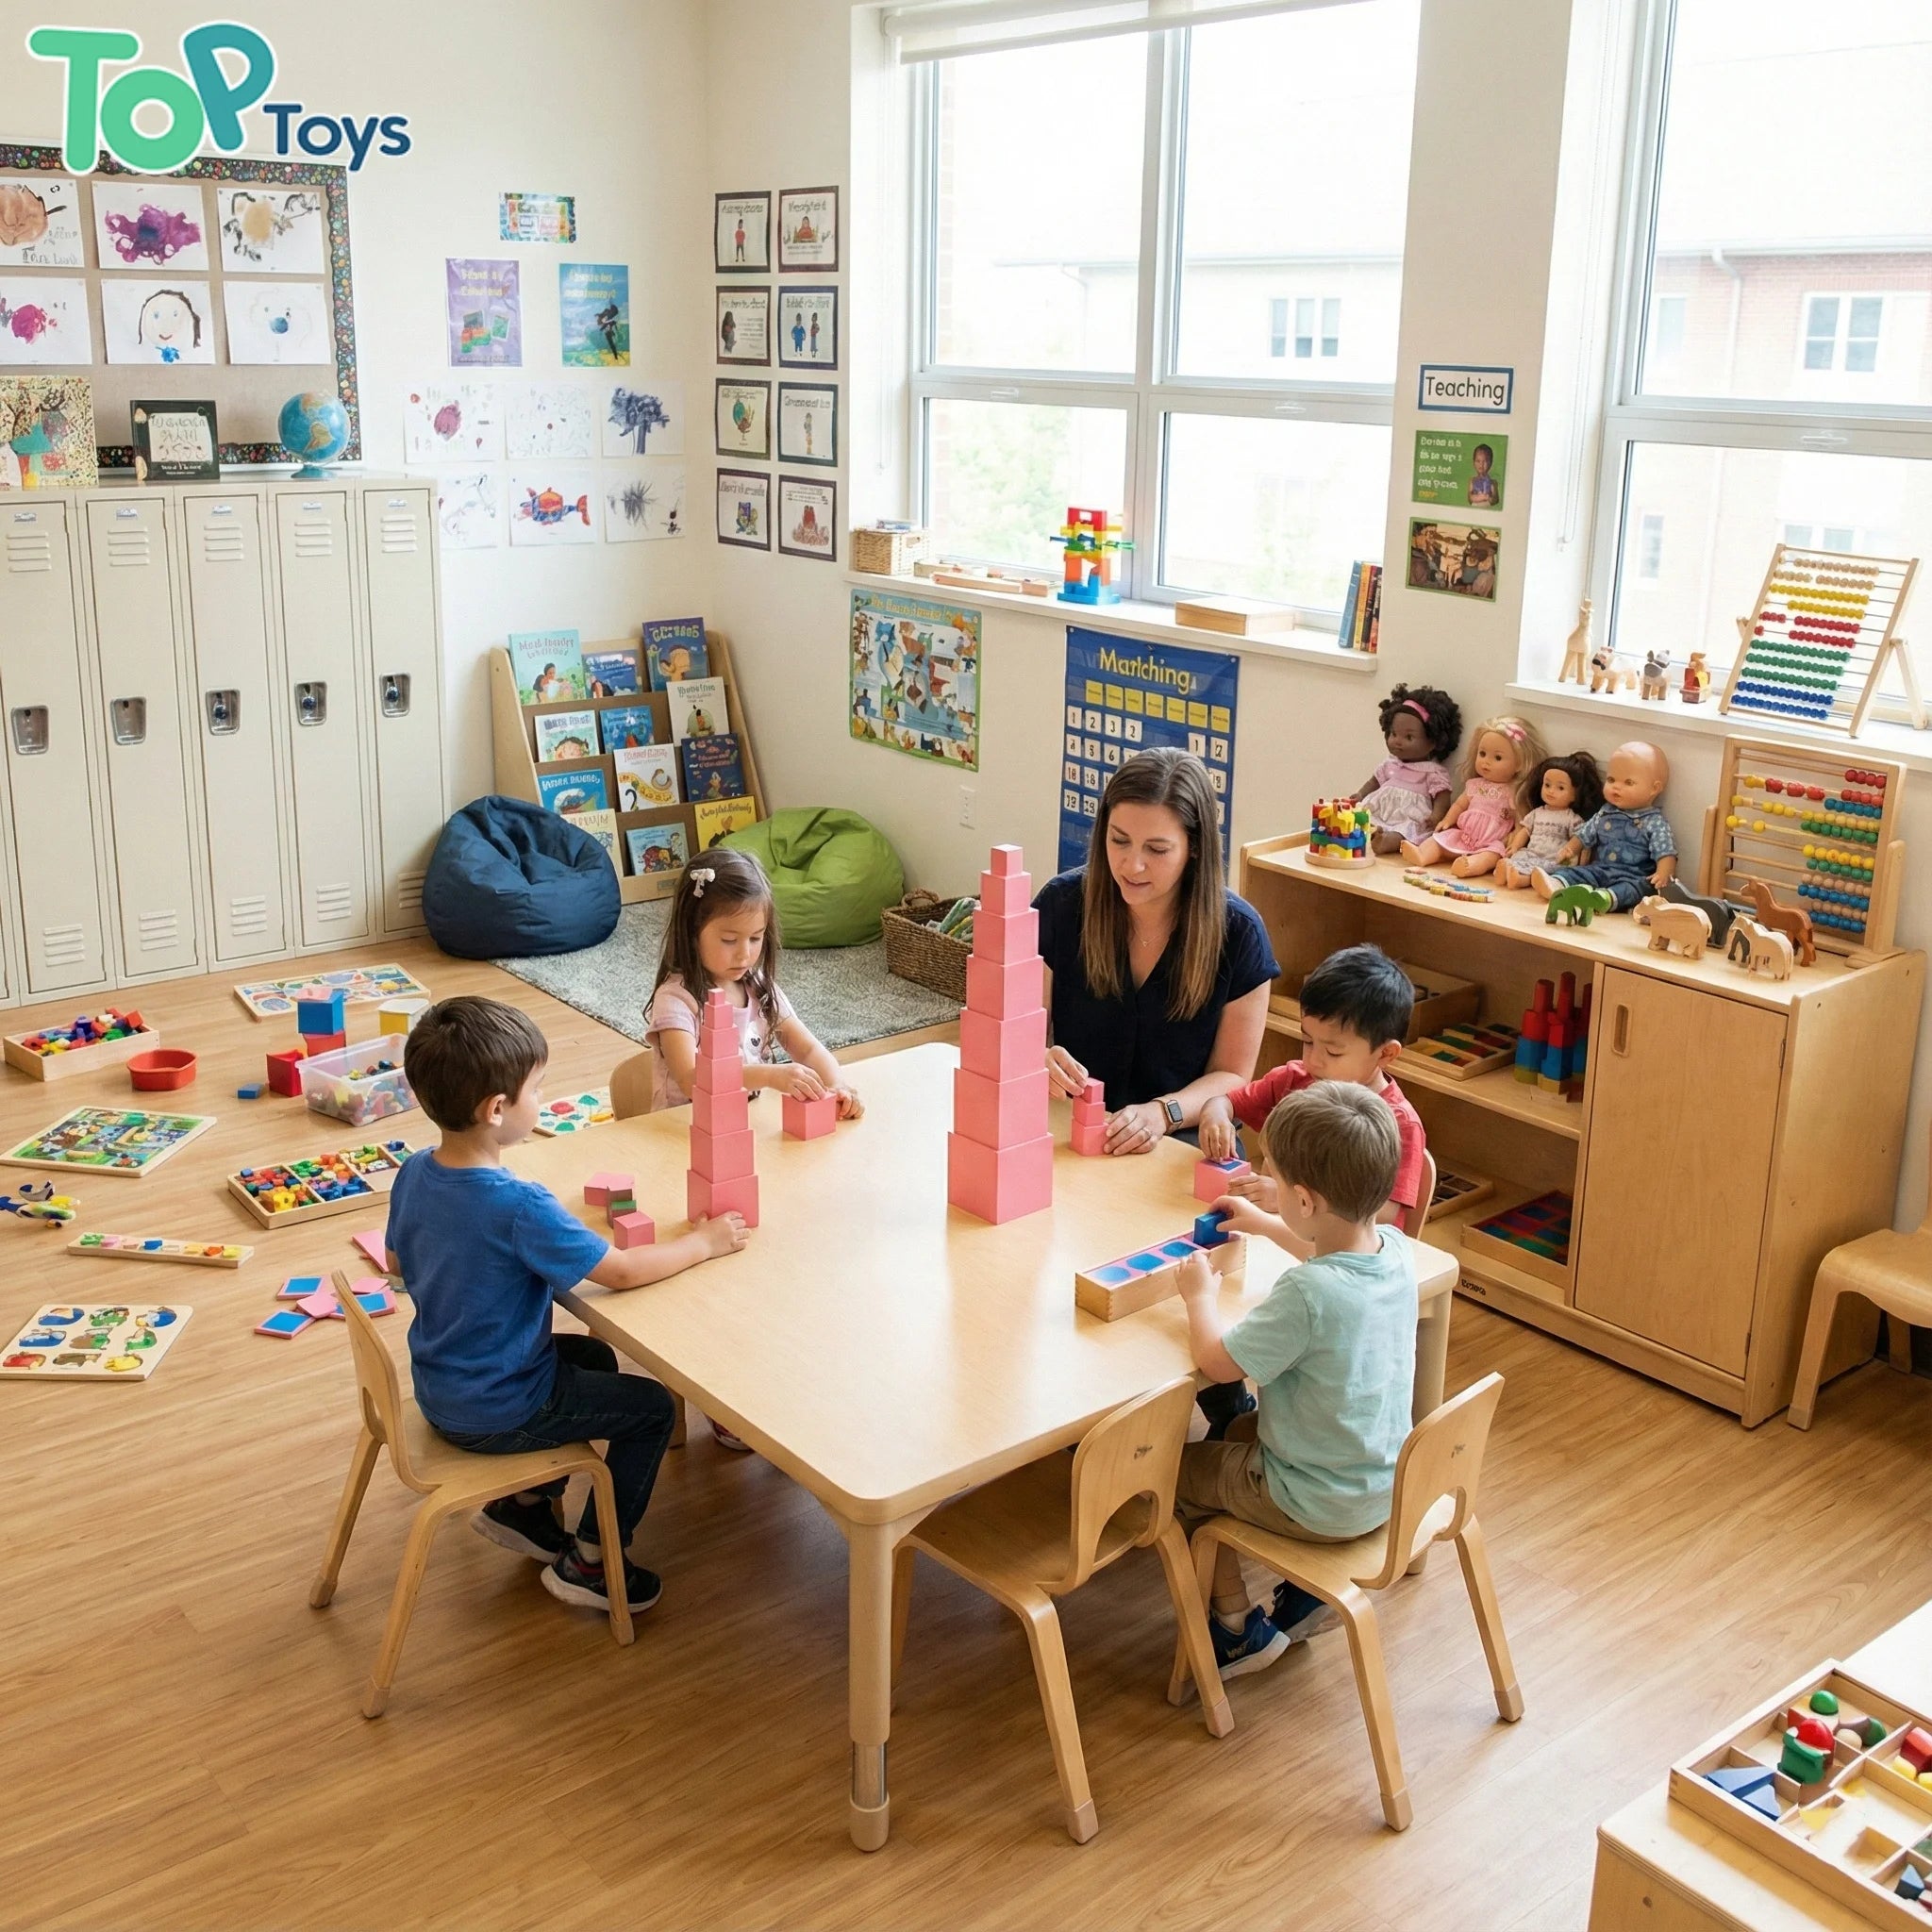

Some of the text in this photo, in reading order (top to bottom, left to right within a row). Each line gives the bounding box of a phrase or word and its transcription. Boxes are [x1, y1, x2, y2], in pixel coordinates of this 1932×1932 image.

[1425, 376, 1505, 406] Teaching
[1090, 716, 1096, 729] 2
[1108, 750, 1115, 762] 6
